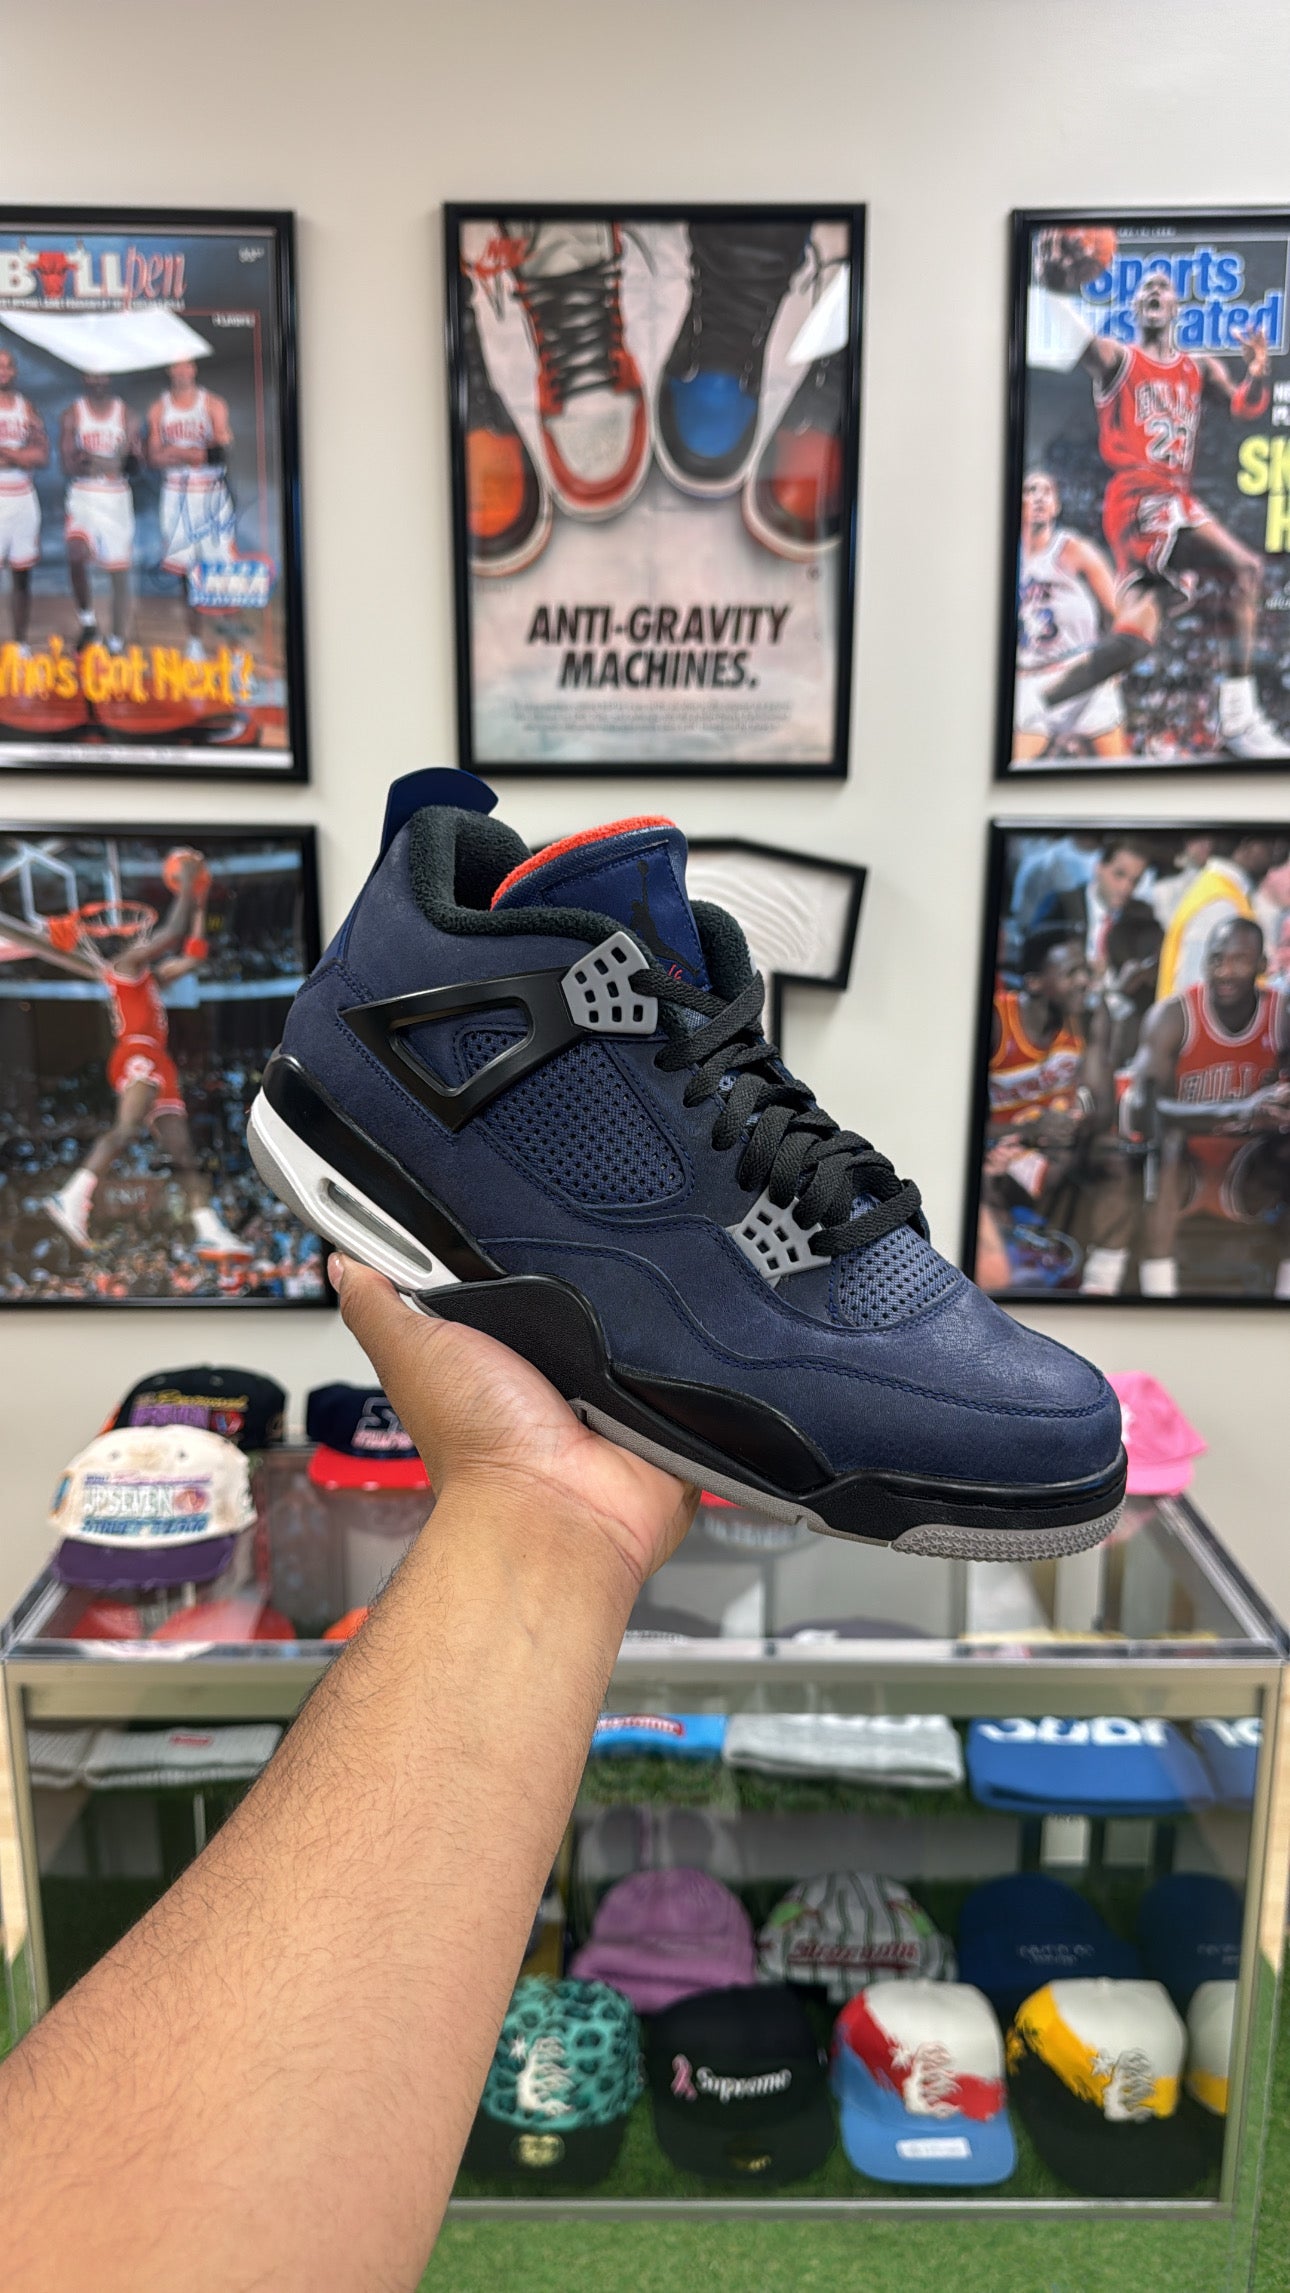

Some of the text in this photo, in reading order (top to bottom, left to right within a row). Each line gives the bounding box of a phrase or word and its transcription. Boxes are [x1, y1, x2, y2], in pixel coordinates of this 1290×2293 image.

[527, 604, 792, 646] ANTI-GRAVITY
[0, 633, 78, 699] ho's
[82, 642, 149, 704] Got
[557, 650, 760, 692] MACHINES.
